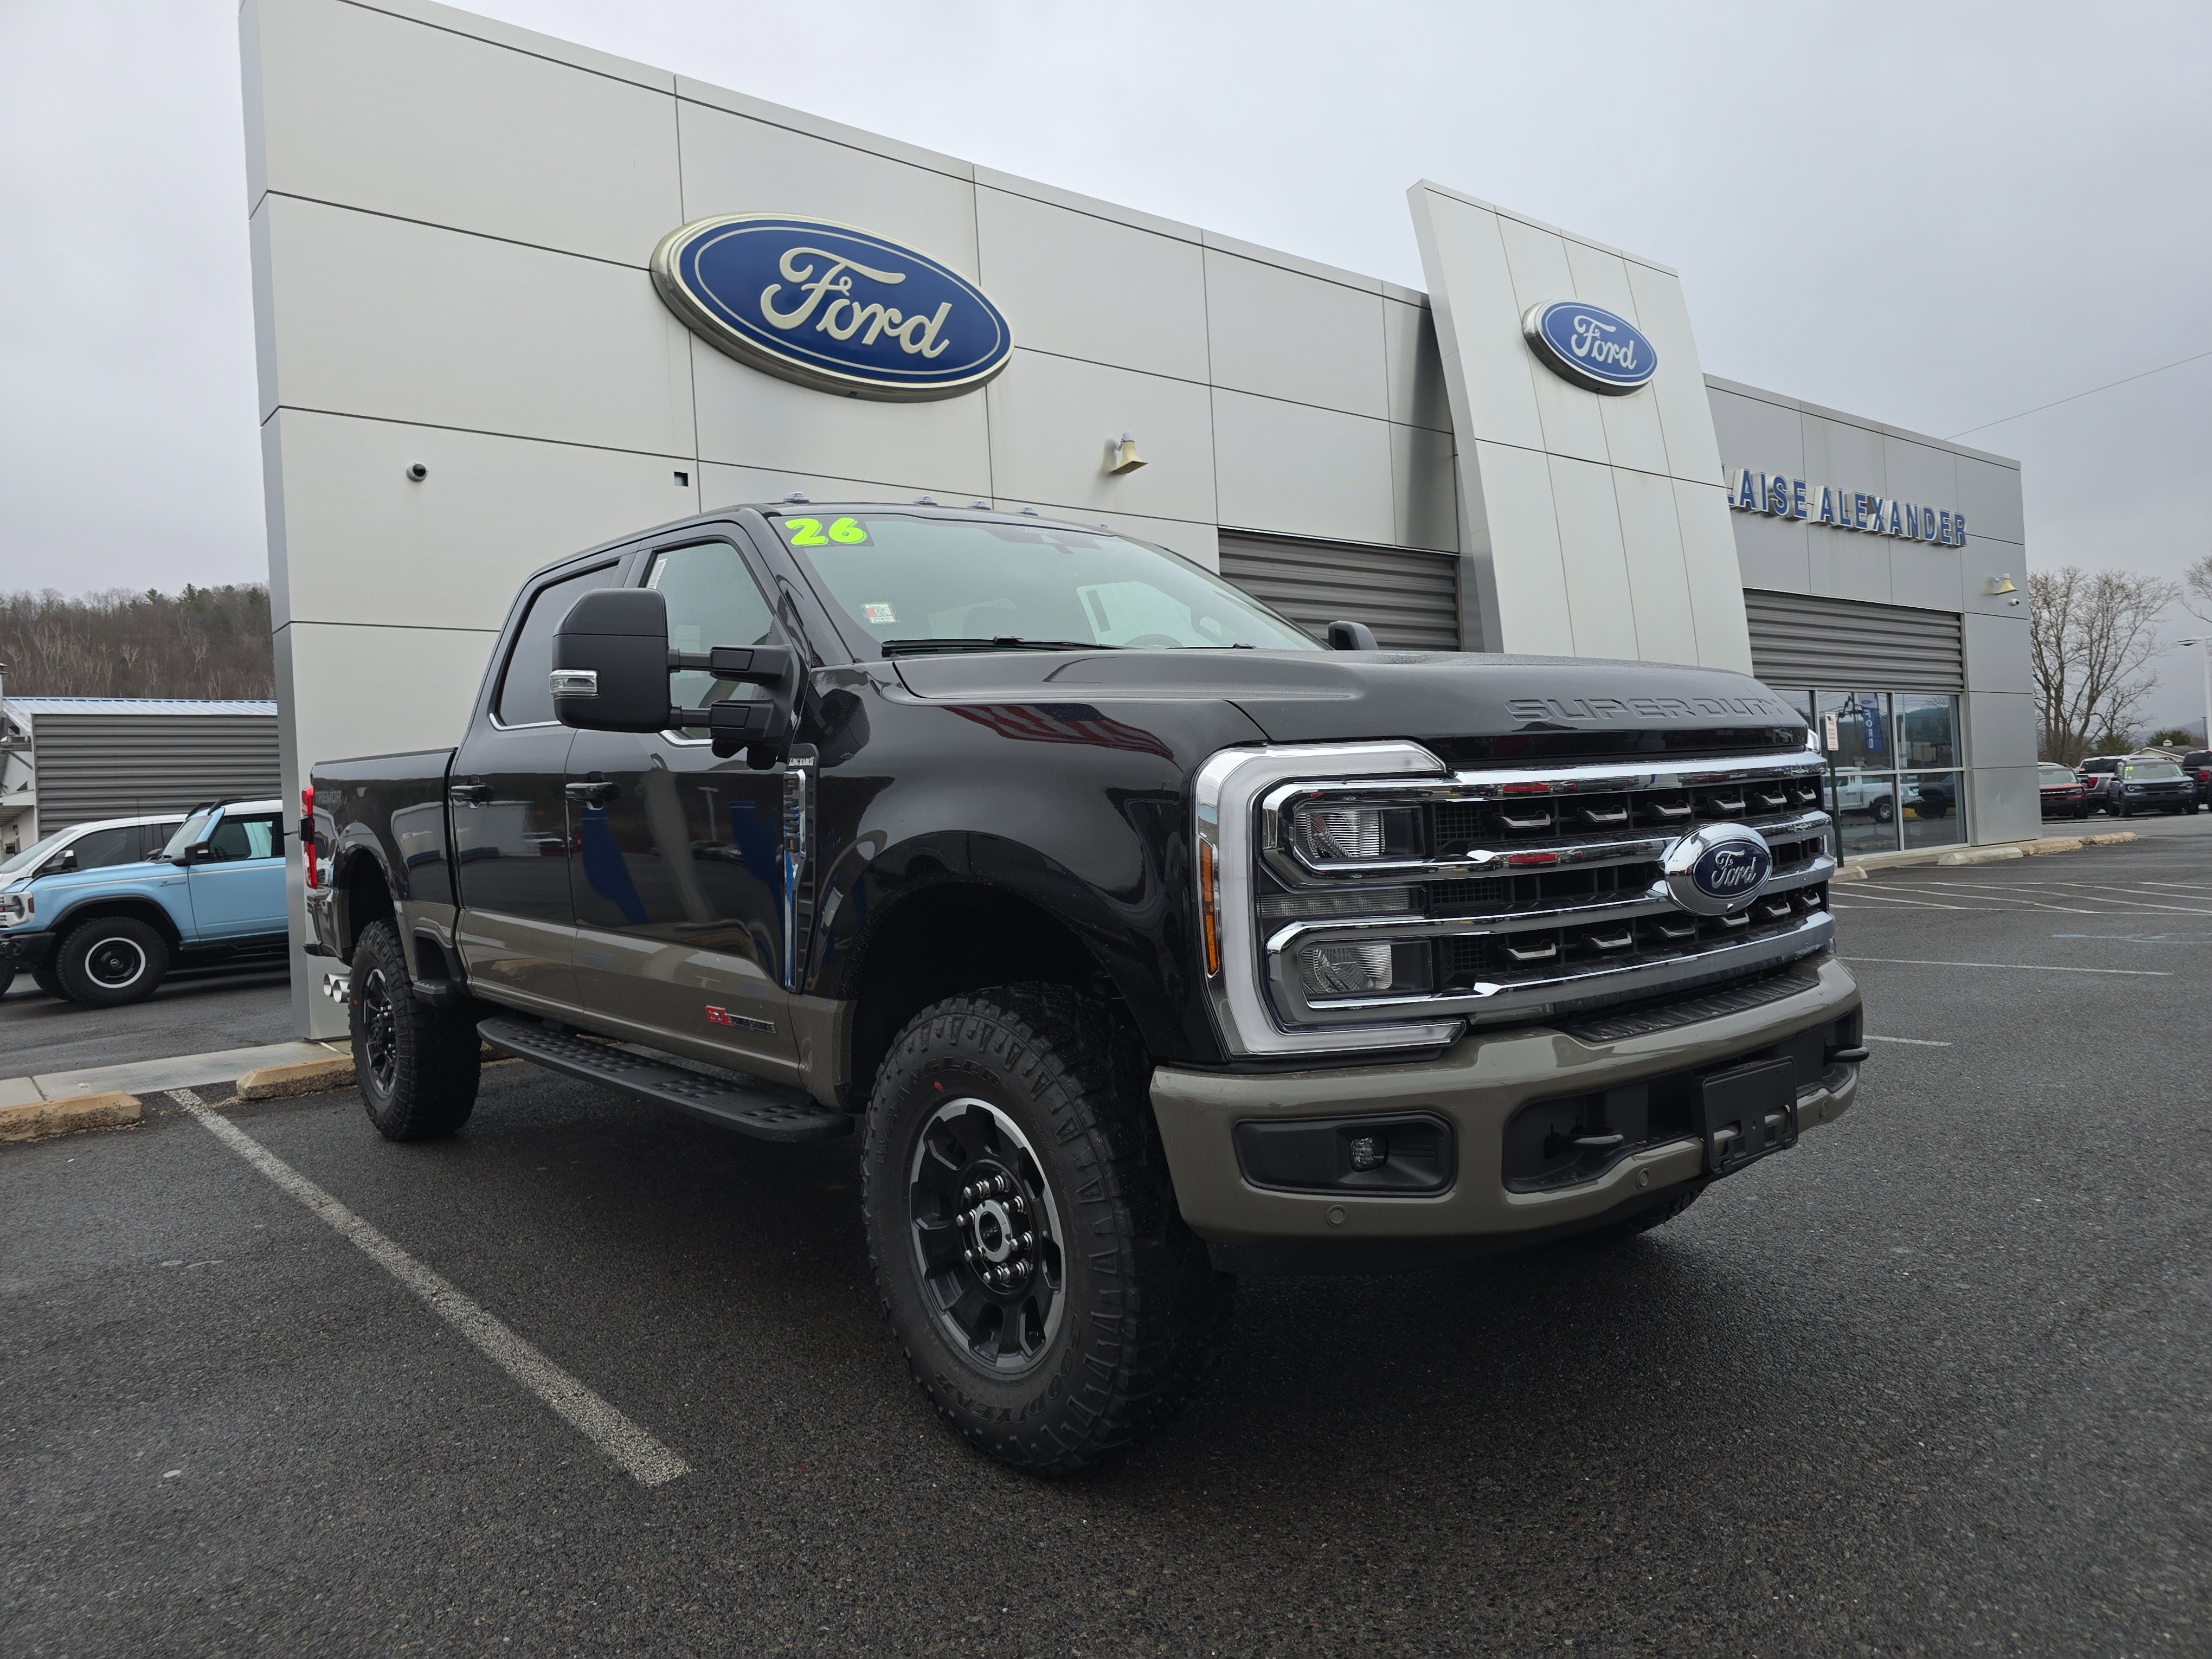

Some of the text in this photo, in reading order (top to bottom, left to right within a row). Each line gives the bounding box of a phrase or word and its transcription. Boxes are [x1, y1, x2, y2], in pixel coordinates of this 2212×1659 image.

[760, 246, 953, 358] Ford
[1571, 315, 1637, 370] Ford
[785, 517, 867, 546] 26
[1817, 485, 1967, 548] ALEXANDER
[1503, 697, 1785, 722] SUPER DUTY
[314, 790, 342, 805] TREMOR
[1711, 850, 1757, 889] Ford
